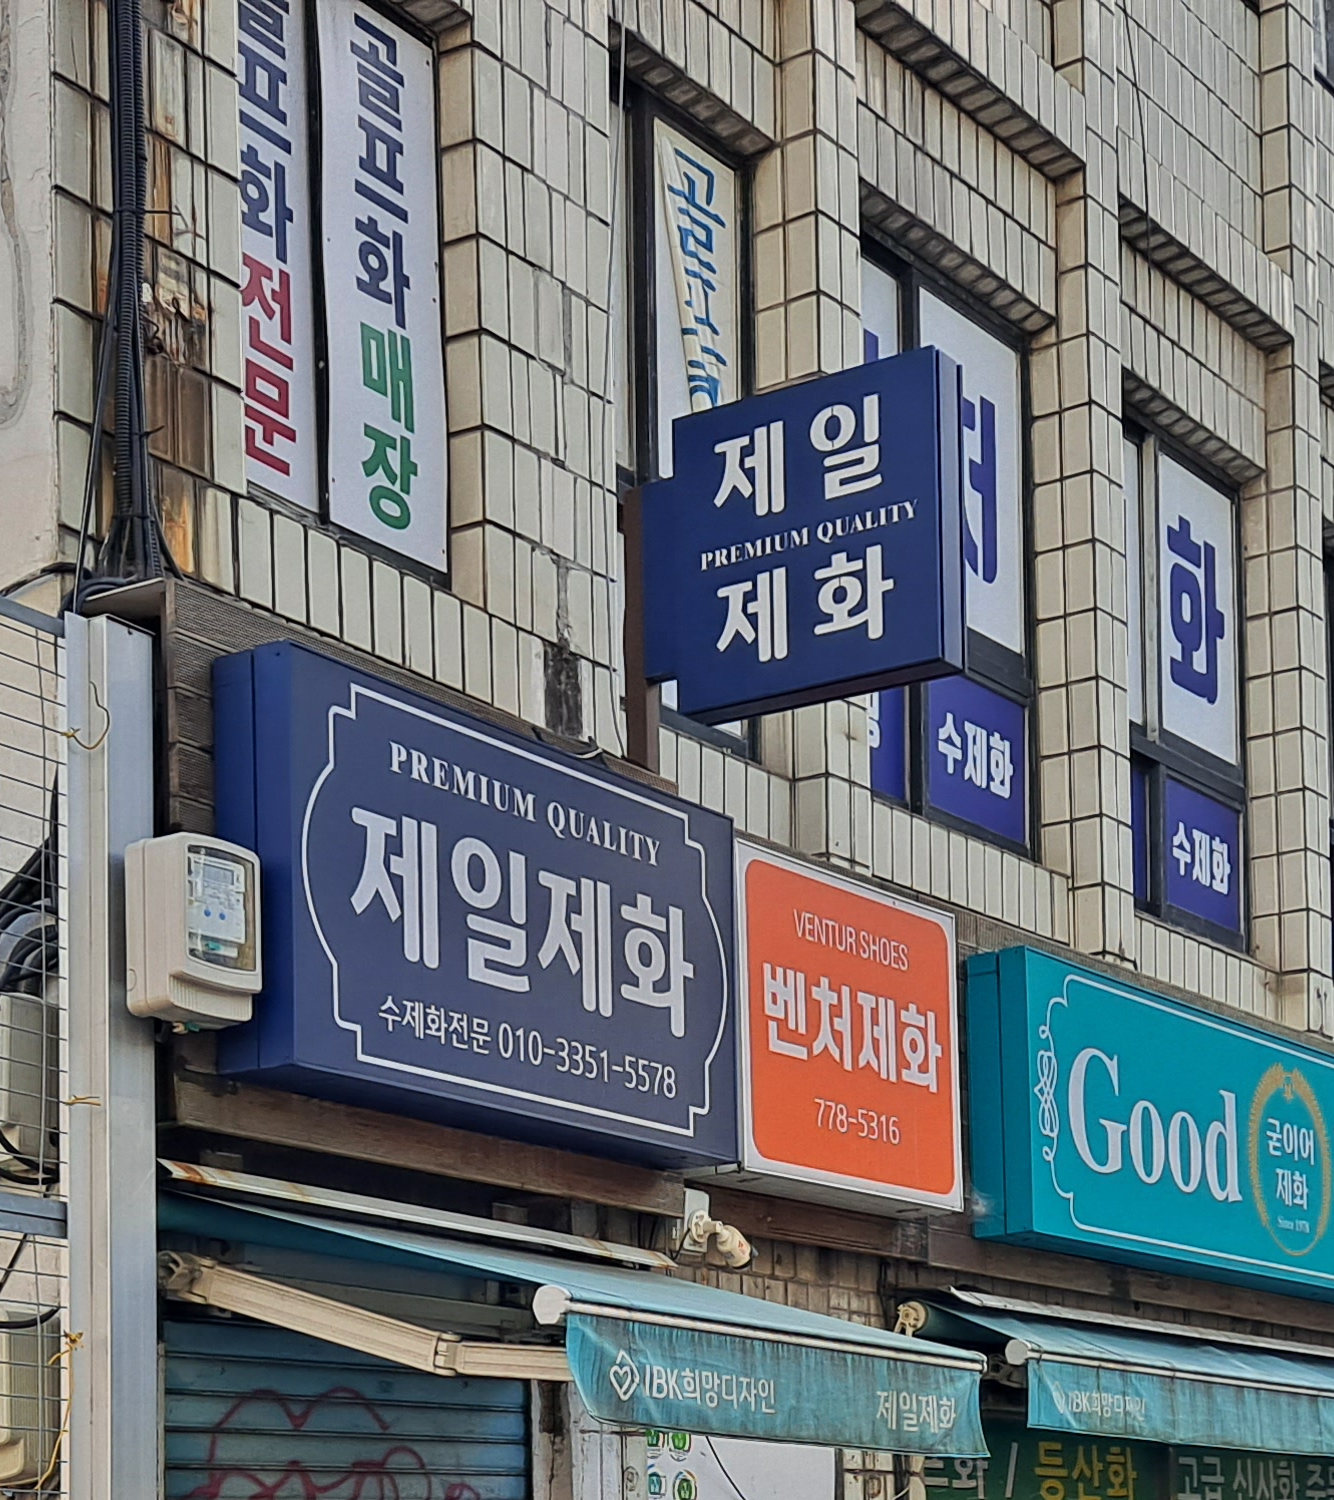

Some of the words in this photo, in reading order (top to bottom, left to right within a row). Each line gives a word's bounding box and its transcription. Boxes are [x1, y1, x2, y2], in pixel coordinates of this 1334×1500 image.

[350, 13, 411, 329] 골프화
[240, 250, 299, 477] 전문
[359, 322, 419, 532] 매장
[713, 394, 883, 517] 제일
[700, 527, 809, 571] PREMIUM
[816, 500, 918, 542] QUALITY
[715, 545, 895, 663] 제화
[390, 741, 537, 823] PREMIUM
[547, 800, 661, 867] QUALITY
[938, 713, 1013, 799] 수제화
[1172, 822, 1231, 895] 수제화
[350, 807, 695, 1039] 제일제화
[793, 909, 856, 955] VENTUR
[859, 930, 909, 971] SHOES
[379, 995, 493, 1056] 수제화전문
[498, 1023, 678, 1099] 010-3351-5578
[763, 962, 943, 1093] 벤처제화
[814, 1098, 900, 1145] 778-5316
[1067, 1047, 1243, 1203] Good
[1266, 1118, 1315, 1166] 굳이어
[1275, 1168, 1310, 1211] 제화
[643, 1364, 777, 1414] IBK희망디자인
[876, 1390, 957, 1433] 제일제화
